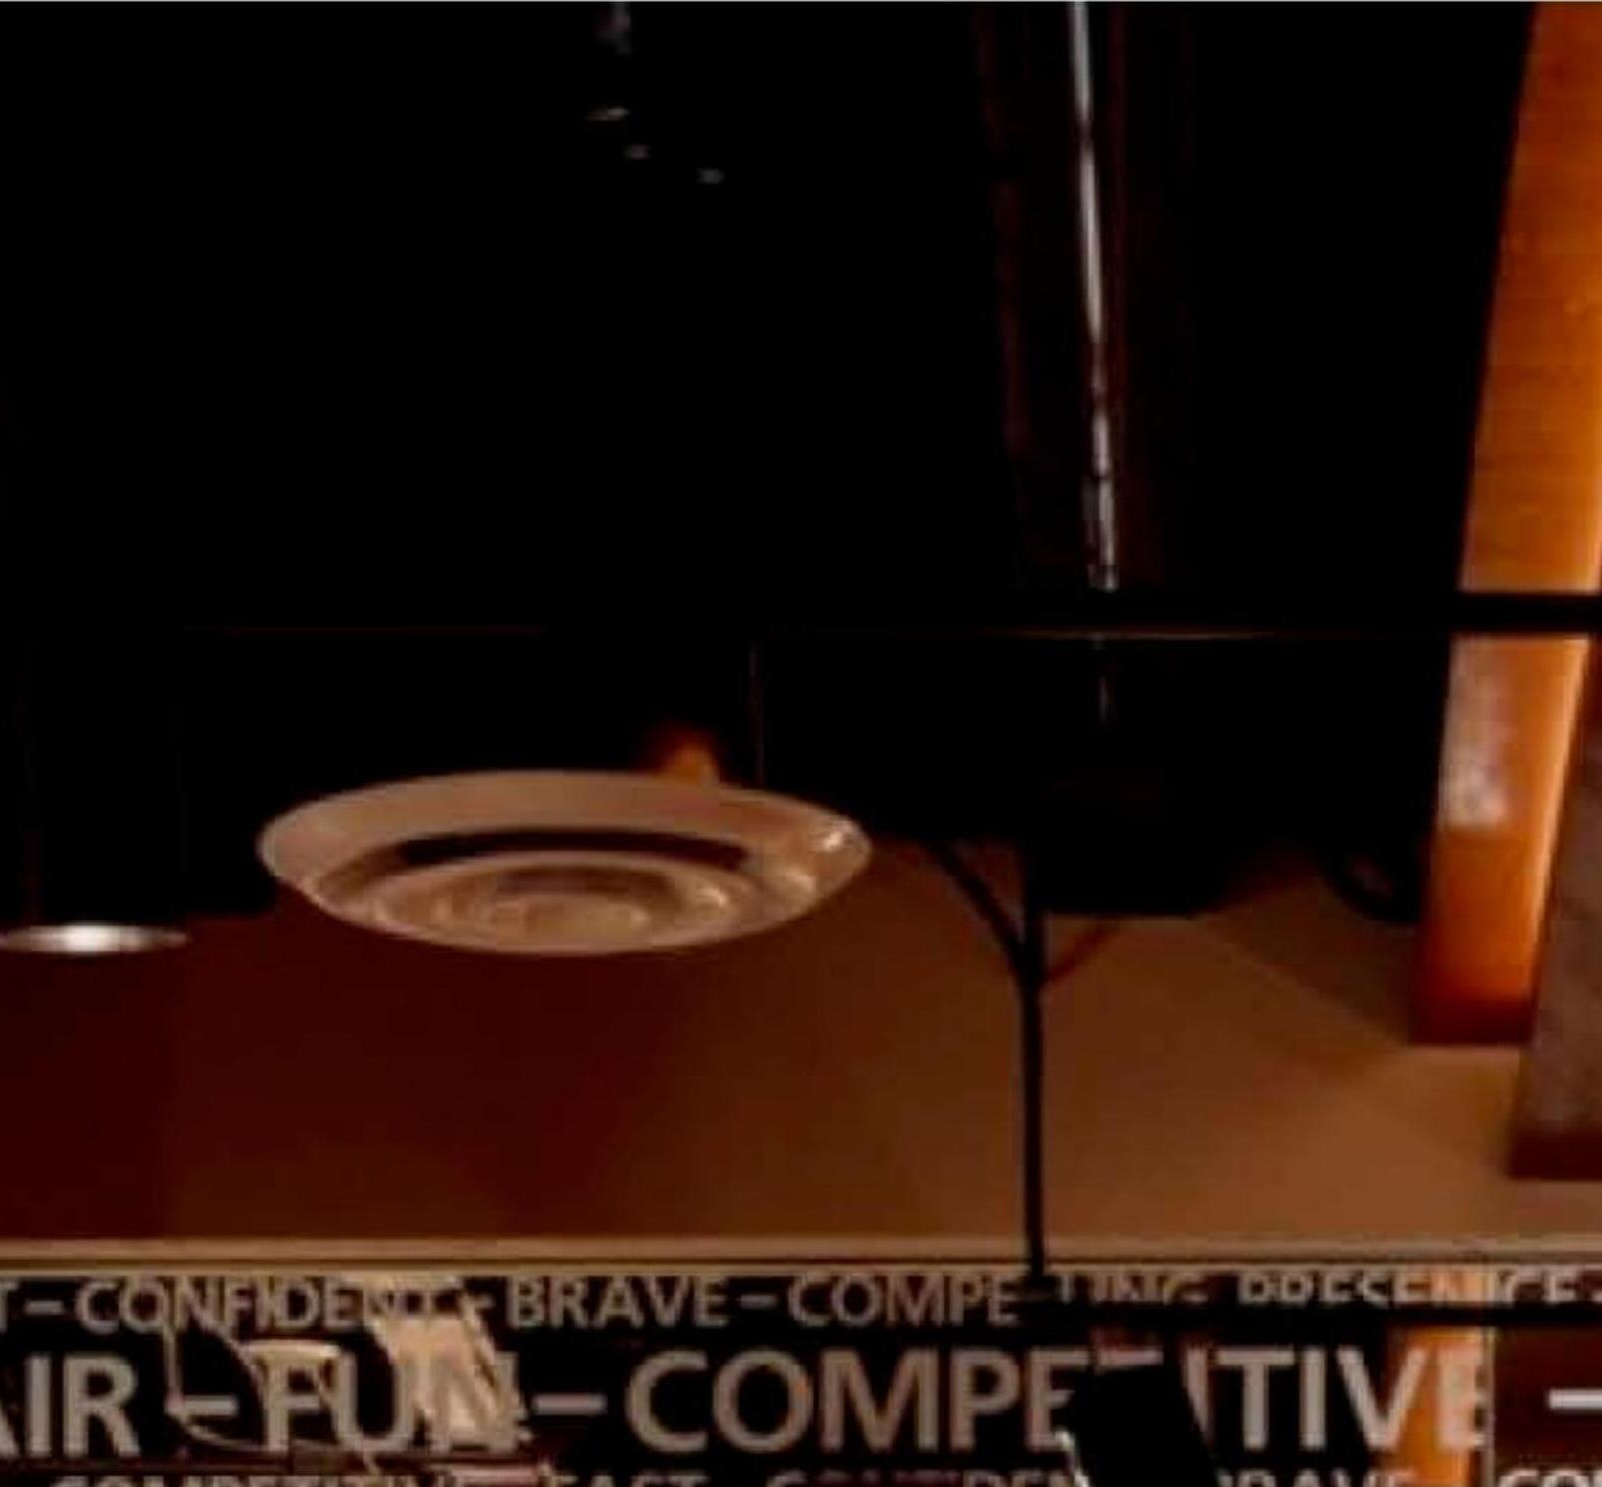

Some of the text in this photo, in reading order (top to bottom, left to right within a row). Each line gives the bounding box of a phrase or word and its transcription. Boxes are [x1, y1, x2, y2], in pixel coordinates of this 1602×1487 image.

[508, 1273, 729, 1328] BRAVE
[264, 1350, 520, 1453] FUN
[624, 1346, 1492, 1452] COMPEITIVE
